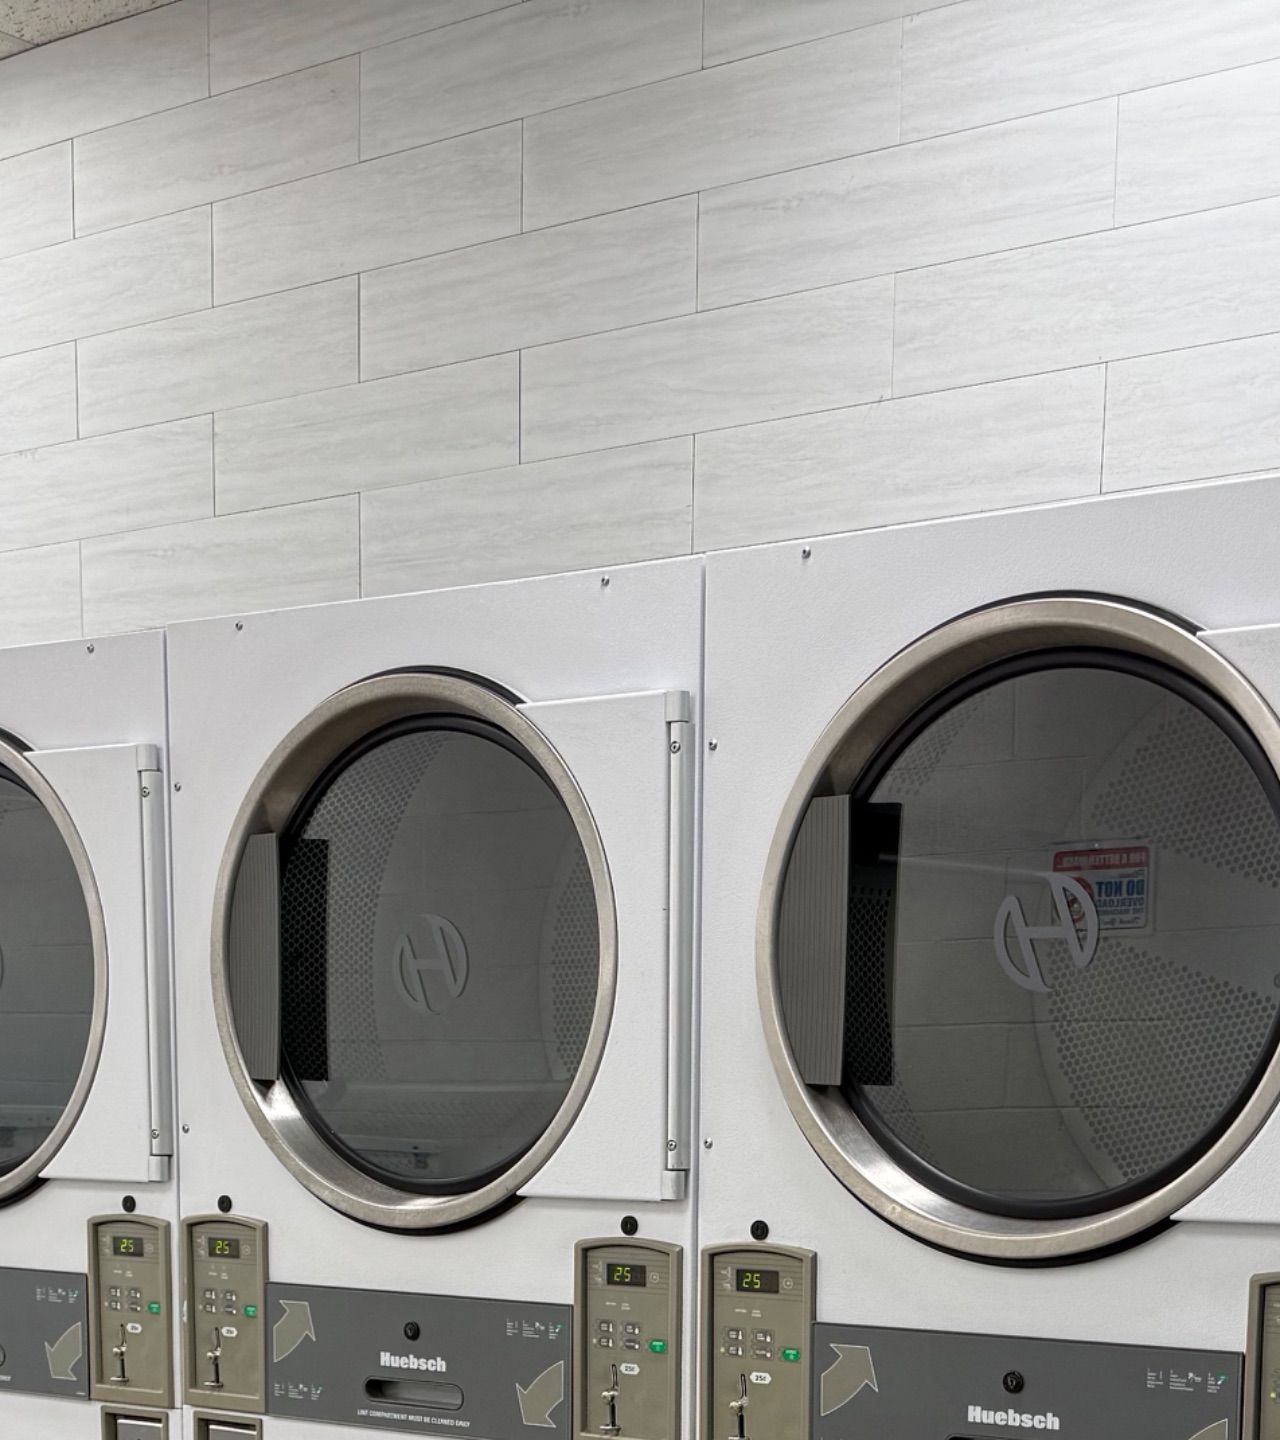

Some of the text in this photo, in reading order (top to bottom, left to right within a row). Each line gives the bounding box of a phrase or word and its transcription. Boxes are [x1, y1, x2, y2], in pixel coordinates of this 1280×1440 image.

[120, 1239, 134, 1252] 25
[215, 1240, 229, 1254] 25
[613, 1267, 631, 1282] 25
[742, 1272, 761, 1289] 25
[379, 1350, 447, 1372] Huebsch
[967, 1405, 1061, 1430] Huebsch
